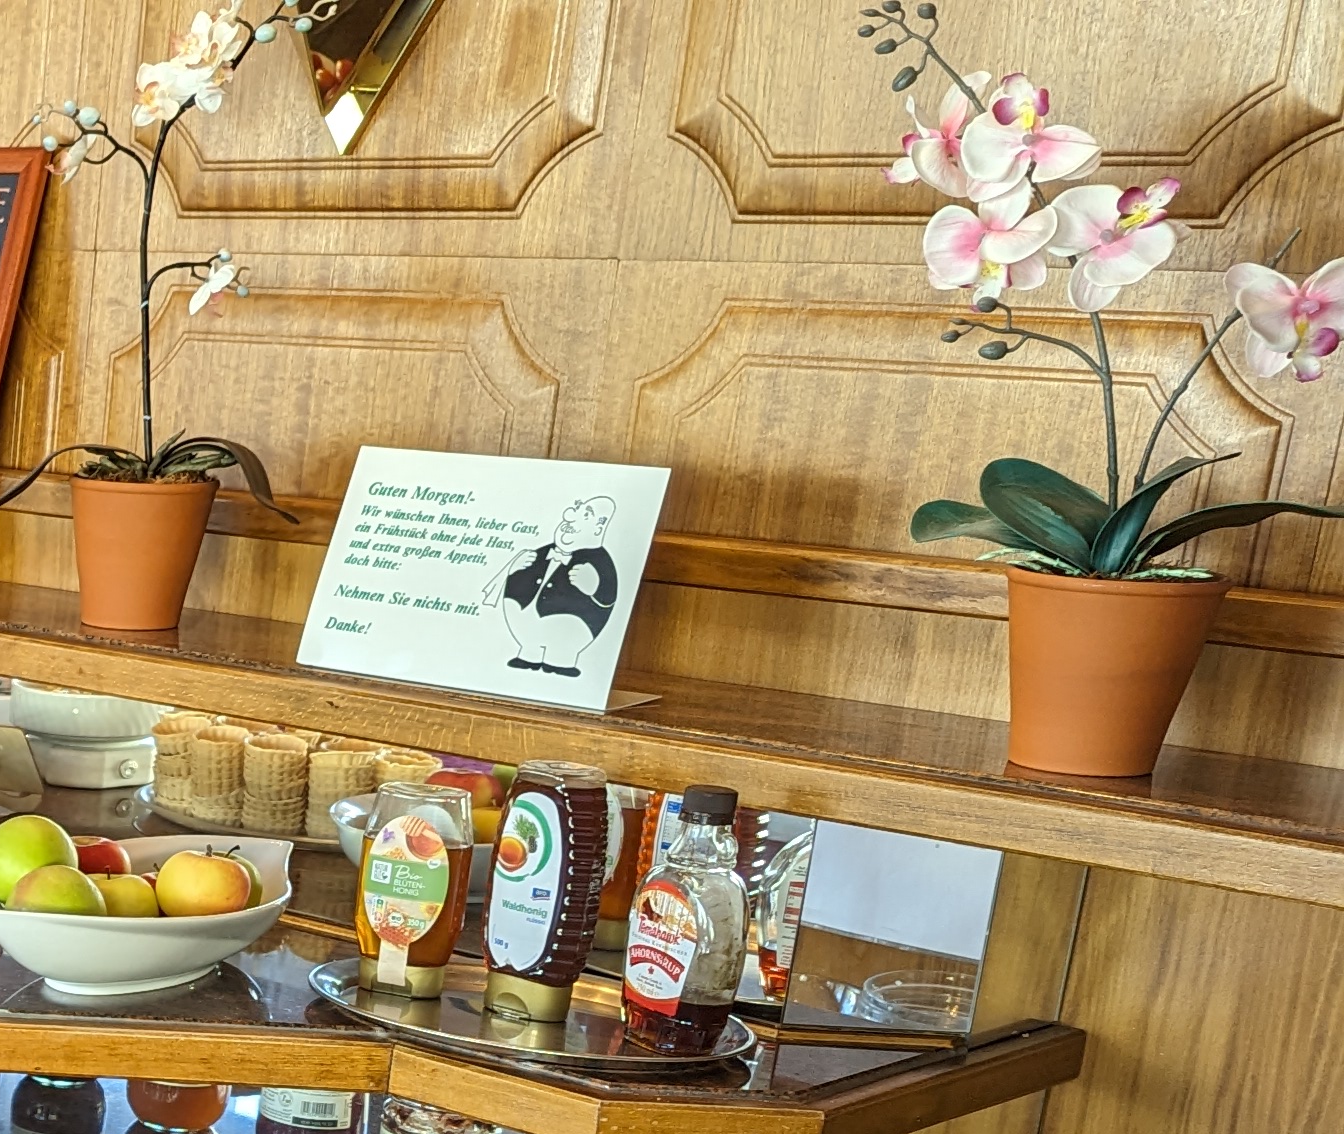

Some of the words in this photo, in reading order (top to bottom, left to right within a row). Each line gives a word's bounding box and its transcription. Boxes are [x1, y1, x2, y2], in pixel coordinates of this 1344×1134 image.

[368, 481, 408, 500] Guten
[360, 505, 382, 518] Wir
[384, 508, 435, 525] wünschen
[437, 513, 471, 530] Ihnen,
[476, 517, 508, 532] lieber
[511, 520, 540, 537] Gast,
[354, 525, 372, 535] ein
[374, 523, 428, 540] Frühstück
[430, 531, 457, 543] ohne
[457, 533, 483, 550] jede
[486, 536, 516, 552] Hast,
[344, 552, 370, 567] doch
[372, 556, 403, 572] bitte:
[349, 538, 370, 551] und
[372, 543, 401, 555] extra
[403, 544, 442, 561] großen
[444, 548, 488, 567] Appetit,
[334, 584, 386, 602] Nehmen
[388, 590, 411, 606] Sie
[413, 594, 452, 612] nichts
[454, 600, 481, 617] mit.
[324, 617, 372, 635] Danke!
[394, 864, 423, 881] Bio
[392, 886, 419, 897] HONIG
[393, 879, 426, 890] BLÜTEN-
[502, 899, 548, 918] Waldhonig
